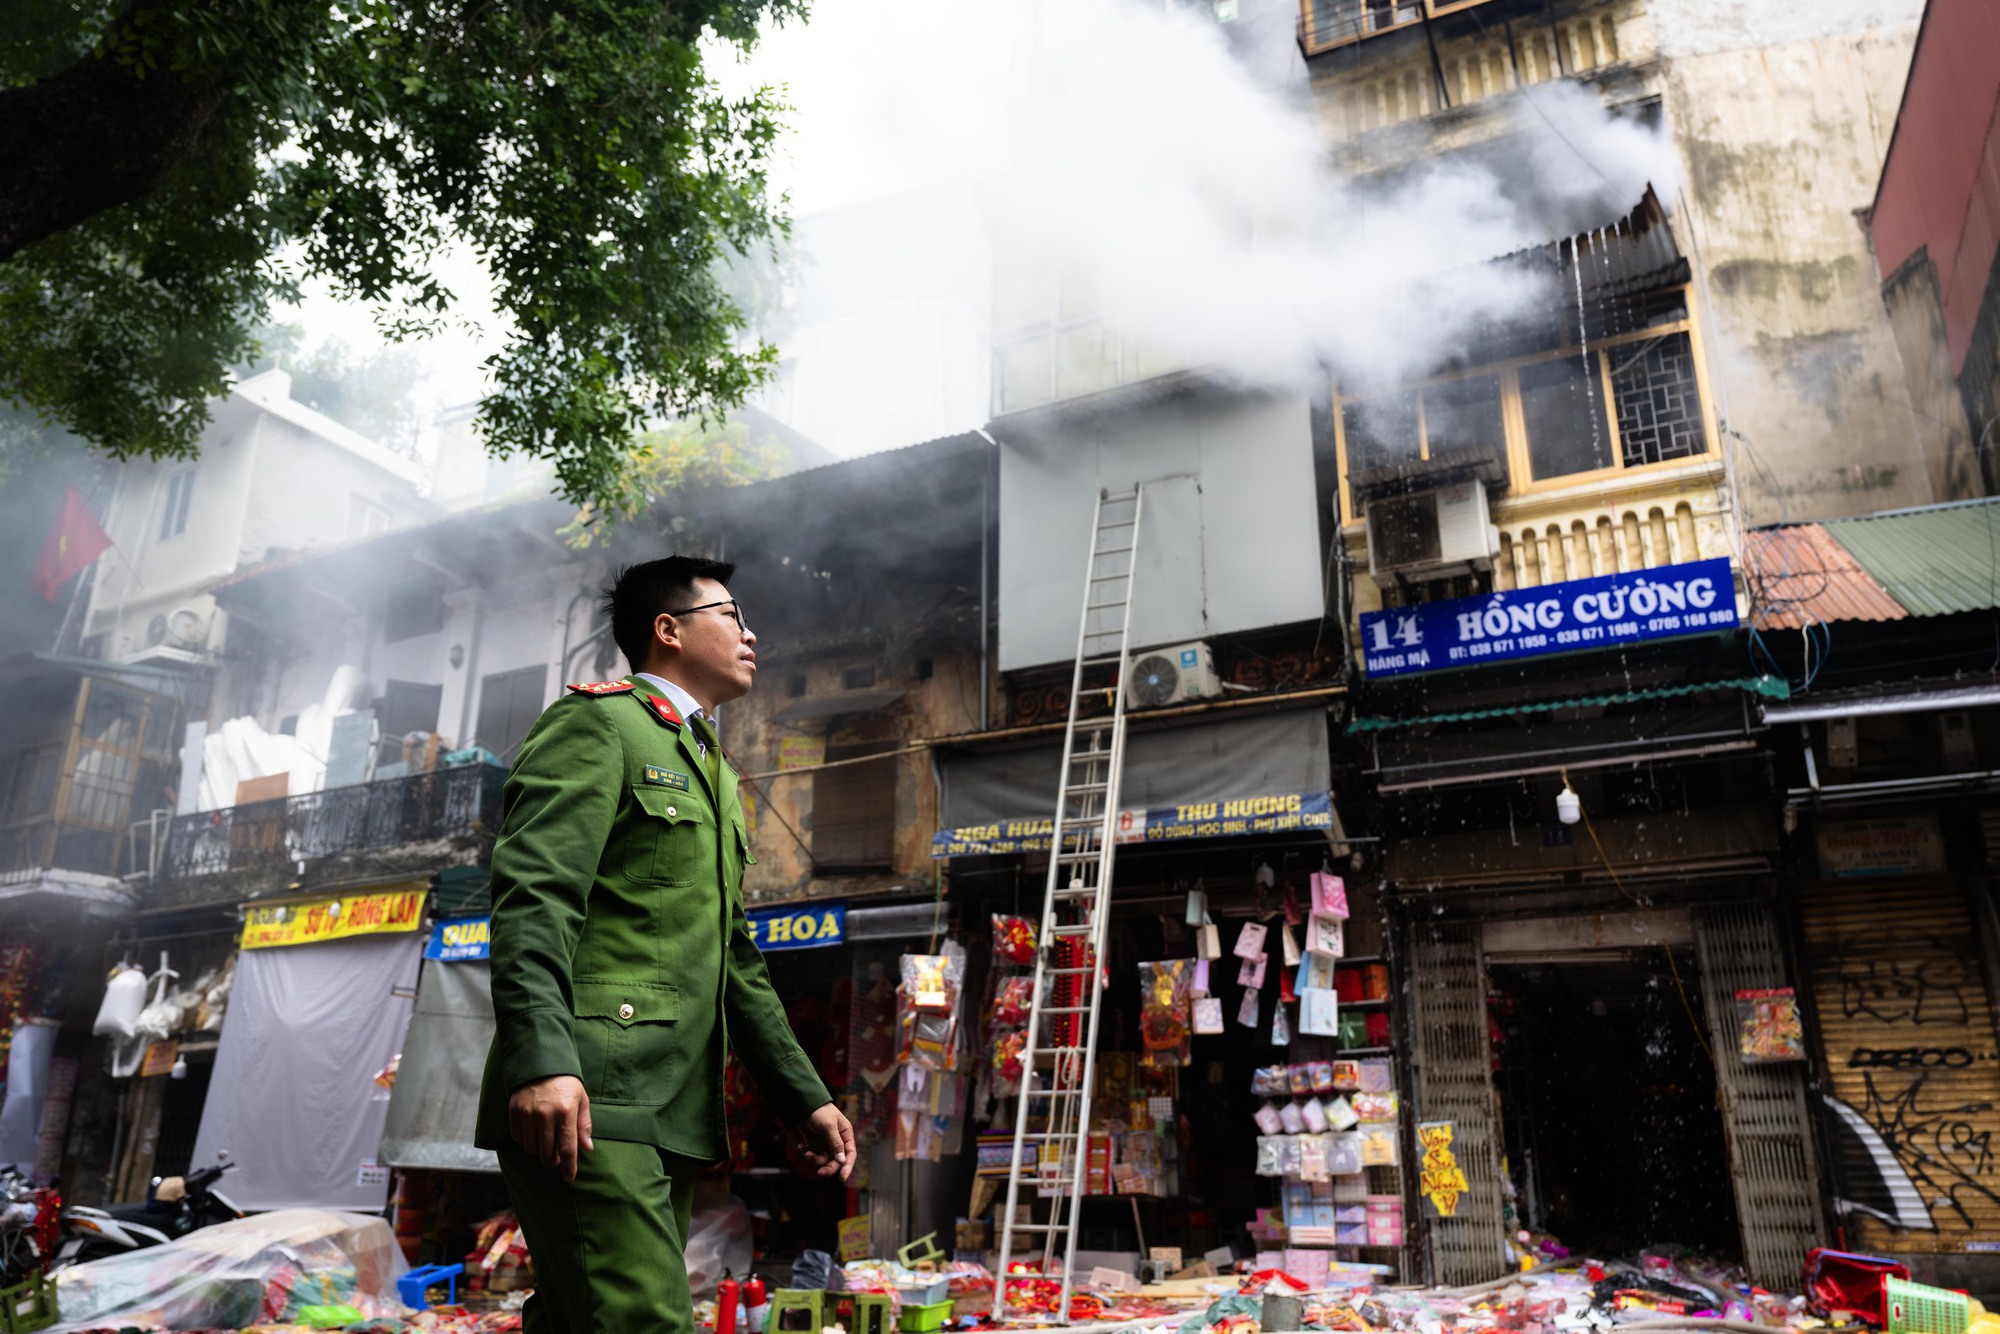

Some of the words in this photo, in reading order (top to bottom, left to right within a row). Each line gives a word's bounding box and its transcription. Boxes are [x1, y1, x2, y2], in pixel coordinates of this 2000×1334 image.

[1456, 593, 1564, 641] HỒNG
[1573, 577, 1717, 623] CƯỜNG
[1366, 614, 1424, 652] 14
[1368, 654, 1406, 672] HÀNG
[1176, 802, 1218, 822] THU
[1223, 793, 1303, 818] HƯƠNG
[1120, 811, 1135, 832] 6
[1222, 820, 1248, 833] SINH
[442, 922, 490, 947] QUA
[766, 912, 841, 943] HOA
